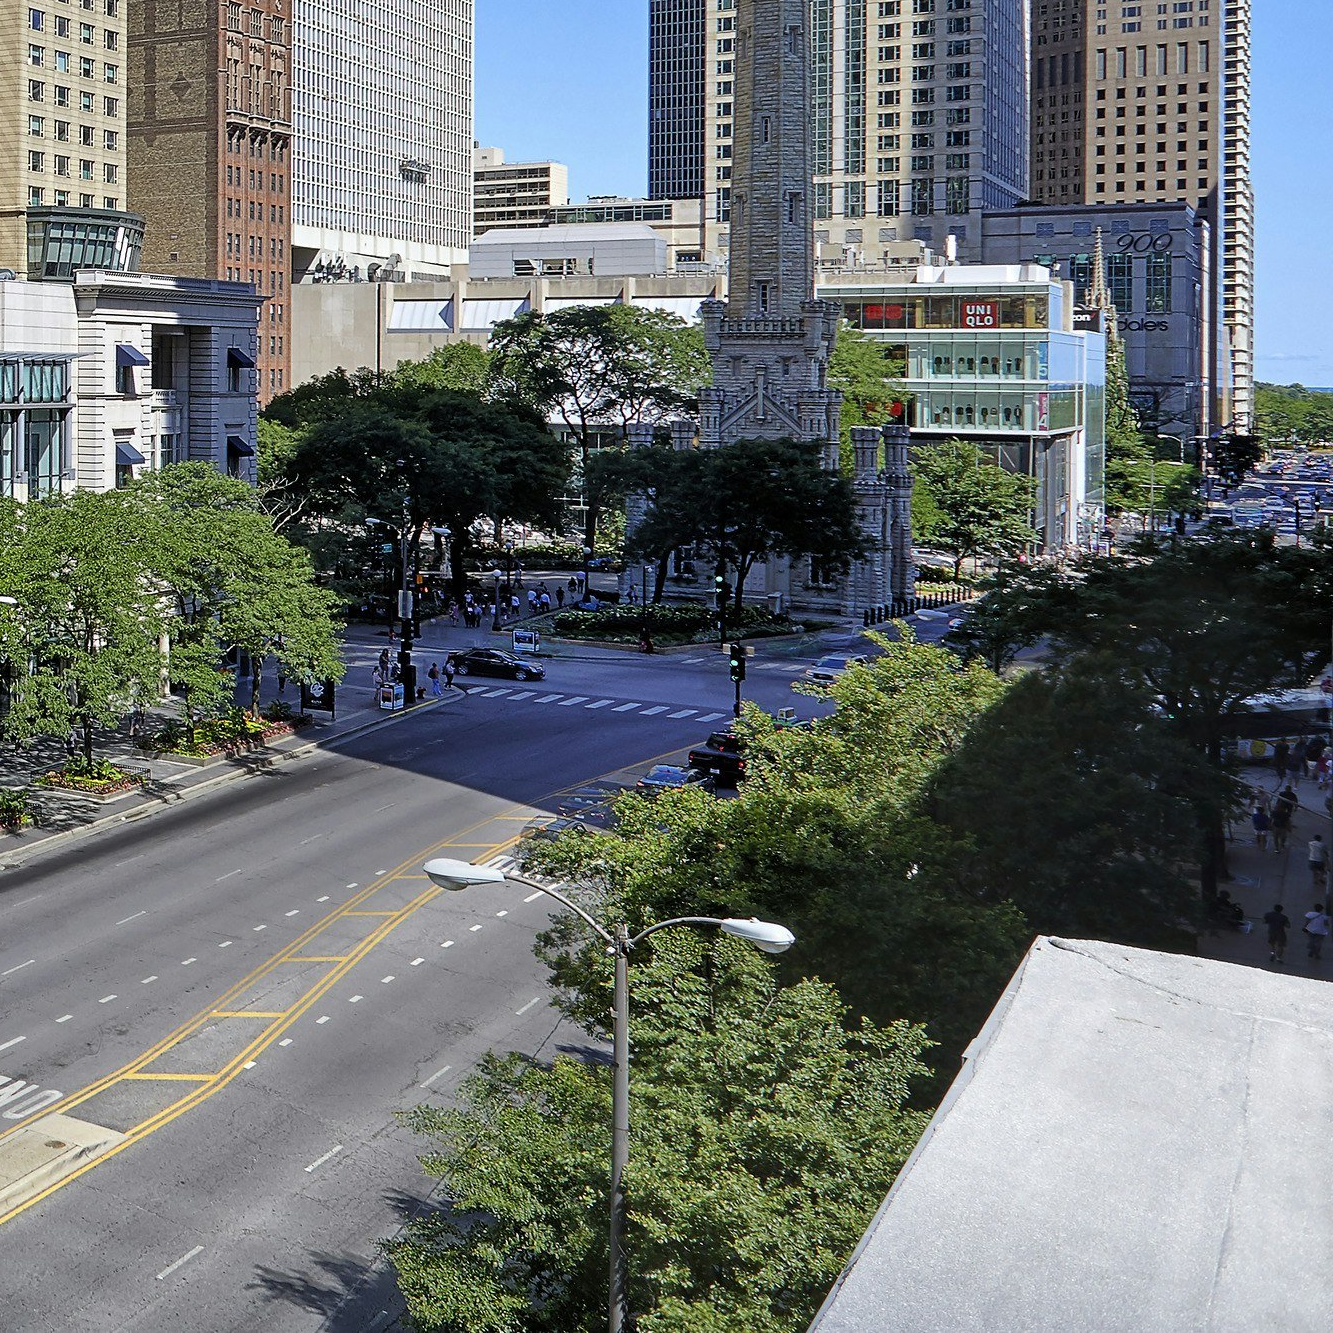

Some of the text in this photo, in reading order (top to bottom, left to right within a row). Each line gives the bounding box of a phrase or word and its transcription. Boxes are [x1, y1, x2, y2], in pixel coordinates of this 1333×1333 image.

[1117, 234, 1172, 254] 900
[966, 305, 992, 315] UNI
[966, 316, 993, 327] QLO
